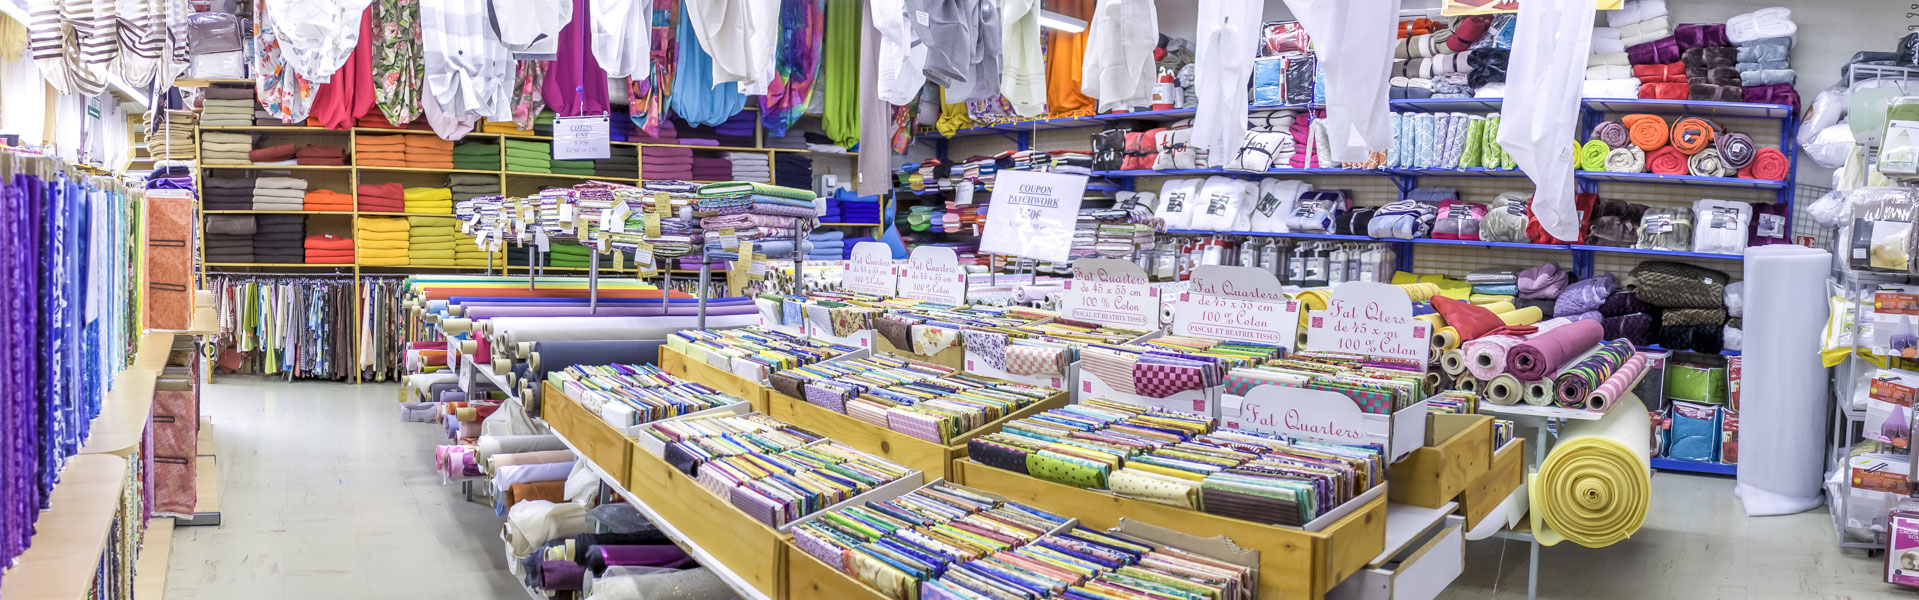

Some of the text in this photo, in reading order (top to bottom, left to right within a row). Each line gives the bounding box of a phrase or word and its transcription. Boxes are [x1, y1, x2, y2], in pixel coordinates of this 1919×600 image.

[1019, 184, 1053, 194] COUPON
[1008, 194, 1060, 207] PATCHWORK
[1074, 266, 1146, 284] Fat Quarters
[1080, 283, 1089, 292] de
[1092, 283, 1103, 294] 45
[1115, 285, 1126, 296] 55
[1192, 278, 1280, 300] Fat Quarters
[1082, 296, 1139, 311] 100 % Coton
[1198, 296, 1210, 306] de
[1330, 298, 1358, 319] Fat
[1102, 313, 1126, 321] BEATRIX
[1202, 310, 1268, 328] 100 % Coton
[1190, 325, 1215, 334] PASCAL
[1226, 329, 1255, 338] BEATRIX
[1256, 332, 1279, 341] TISSUS
[1334, 320, 1350, 332] de
[1352, 322, 1367, 334] 45
[1338, 337, 1419, 356] 100 % Coton
[1246, 403, 1364, 440] Fat Quarters
